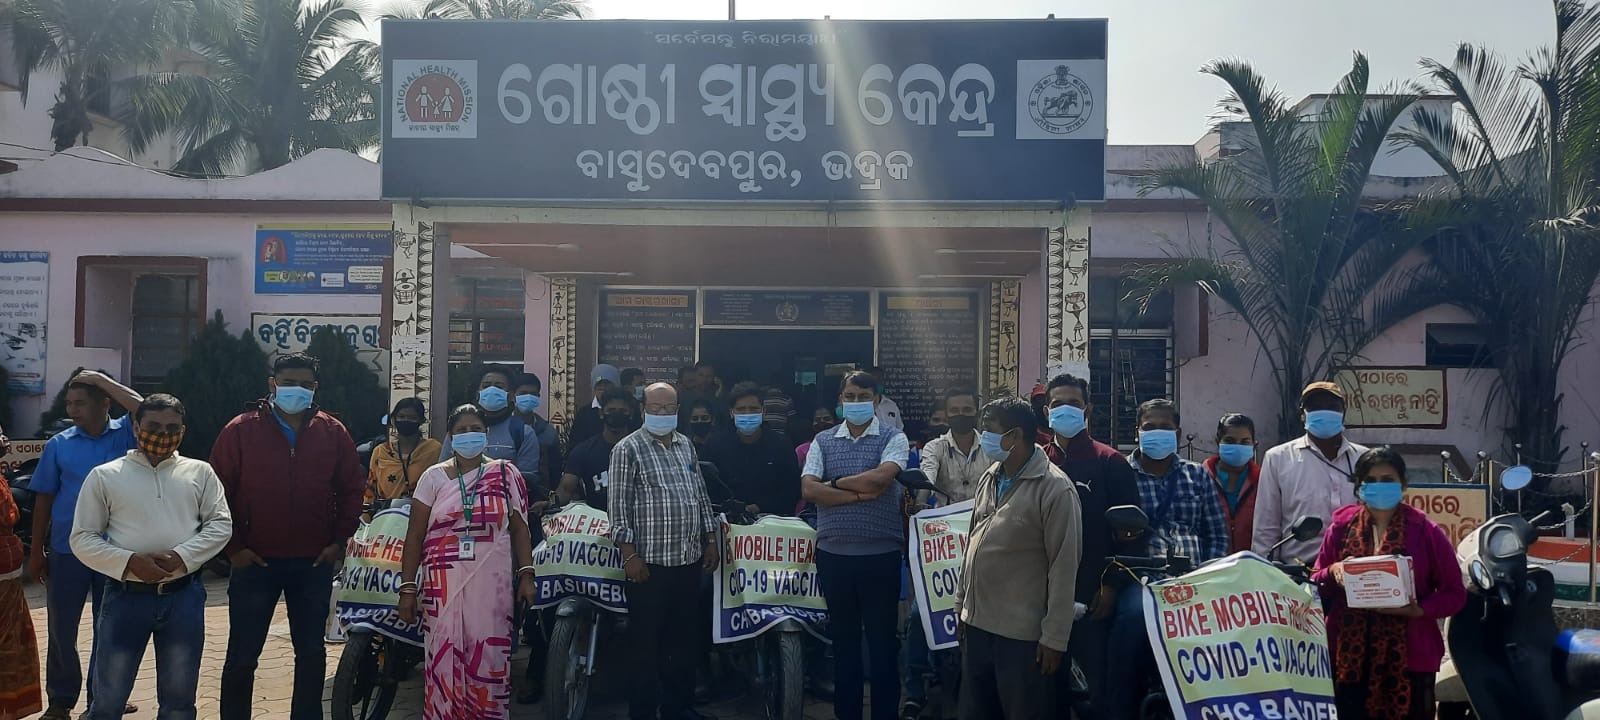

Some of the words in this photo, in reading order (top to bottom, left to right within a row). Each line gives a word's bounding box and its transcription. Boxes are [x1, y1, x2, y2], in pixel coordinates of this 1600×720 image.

[396, 71, 419, 122] NATIONAL
[420, 65, 458, 79] HEALTH
[459, 77, 473, 123] MISSION
[497, 63, 676, 135] ଗୋଷ୍ଠୀ
[858, 63, 996, 137] କେନ୍ଦ୍ର
[821, 150, 914, 190] ଭଦ୍ରକ
[569, 541, 625, 569] VACCIN
[734, 535, 784, 562] MOBILE
[923, 534, 957, 564] BIKE
[773, 570, 824, 598] VACCIN
[1163, 602, 1212, 639] BIKE
[1211, 591, 1288, 633] MOBILE
[1177, 636, 1282, 685] COVID-19
